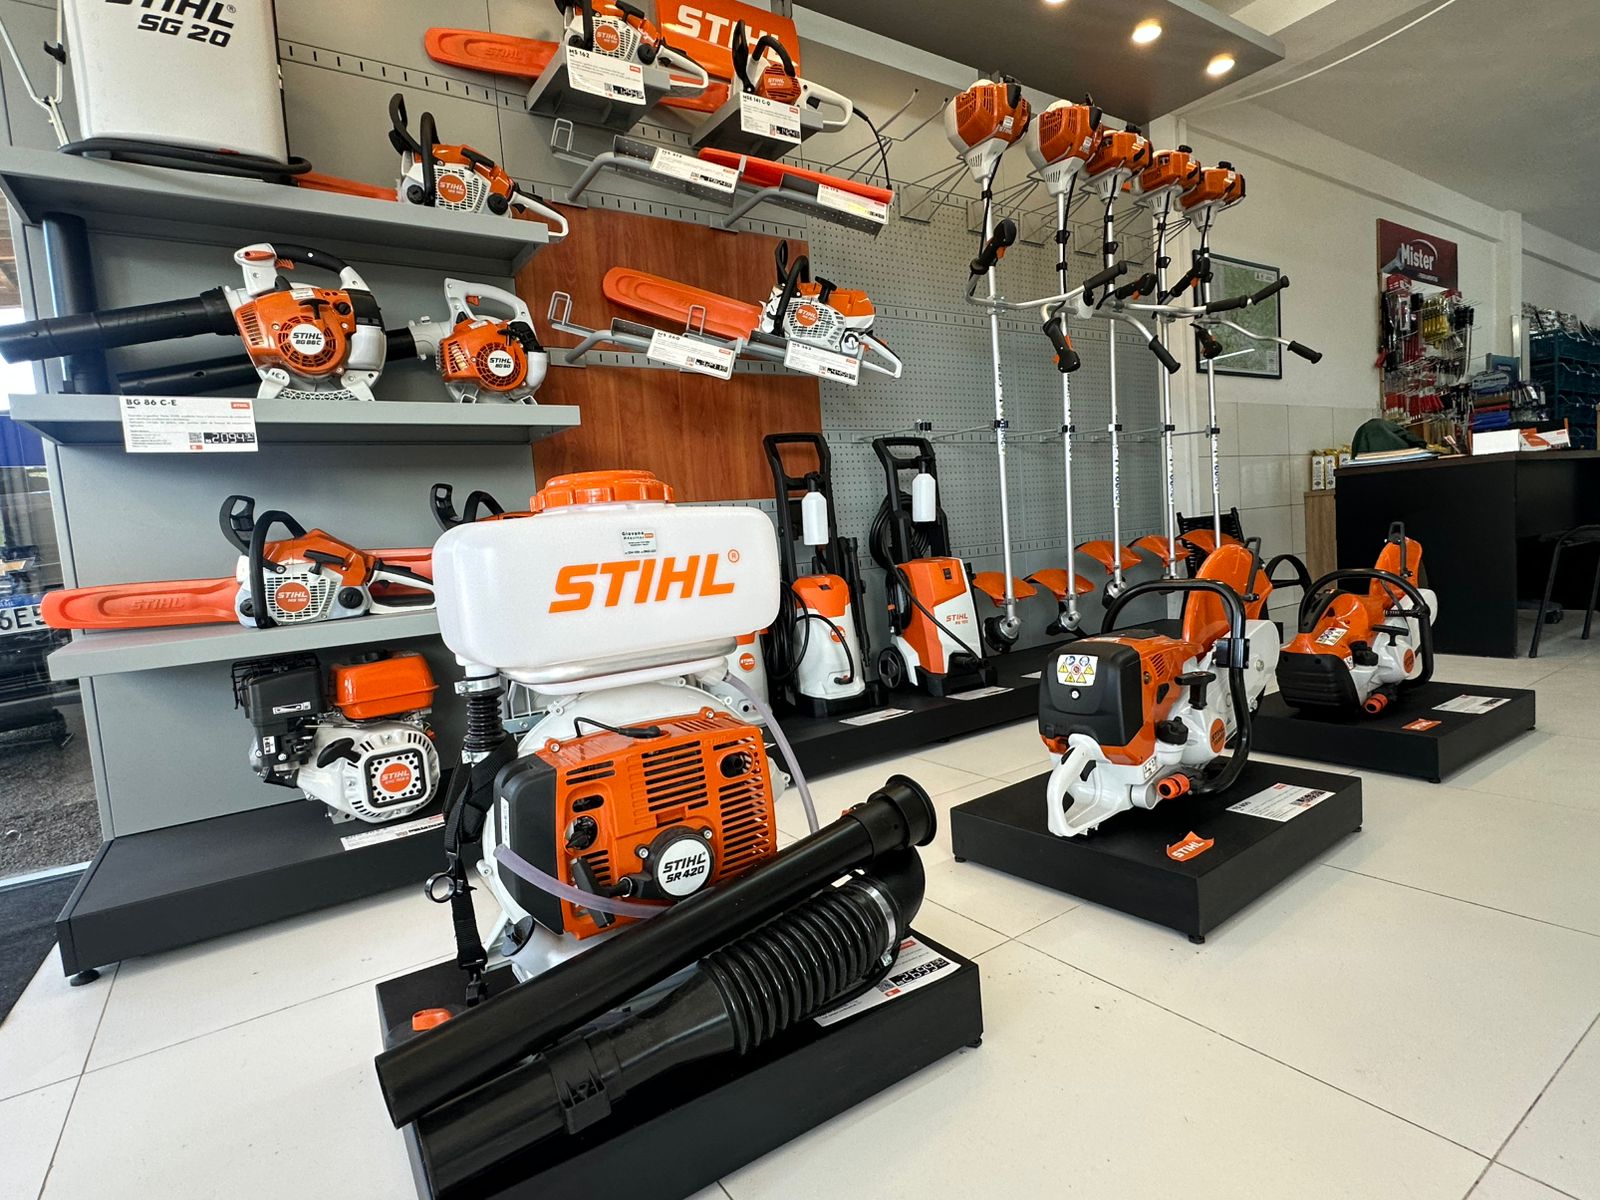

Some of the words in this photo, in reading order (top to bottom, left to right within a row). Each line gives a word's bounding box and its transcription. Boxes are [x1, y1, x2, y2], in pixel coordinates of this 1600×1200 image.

[137, 14, 184, 36] SG
[187, 23, 231, 48] 20
[439, 181, 465, 192] STIHL
[1401, 243, 1435, 271] Mister
[292, 332, 322, 340] STIHL
[125, 398, 141, 406] BG
[548, 553, 735, 614] STIHL
[277, 590, 308, 599] STIHL
[131, 597, 185, 611] STIHL
[946, 613, 969, 622] STIHL
[380, 770, 410, 783] STIHL
[1172, 841, 1205, 859] STIHL
[663, 853, 706, 874] STIHL
[665, 871, 682, 884] SR
[683, 865, 705, 878] 420
